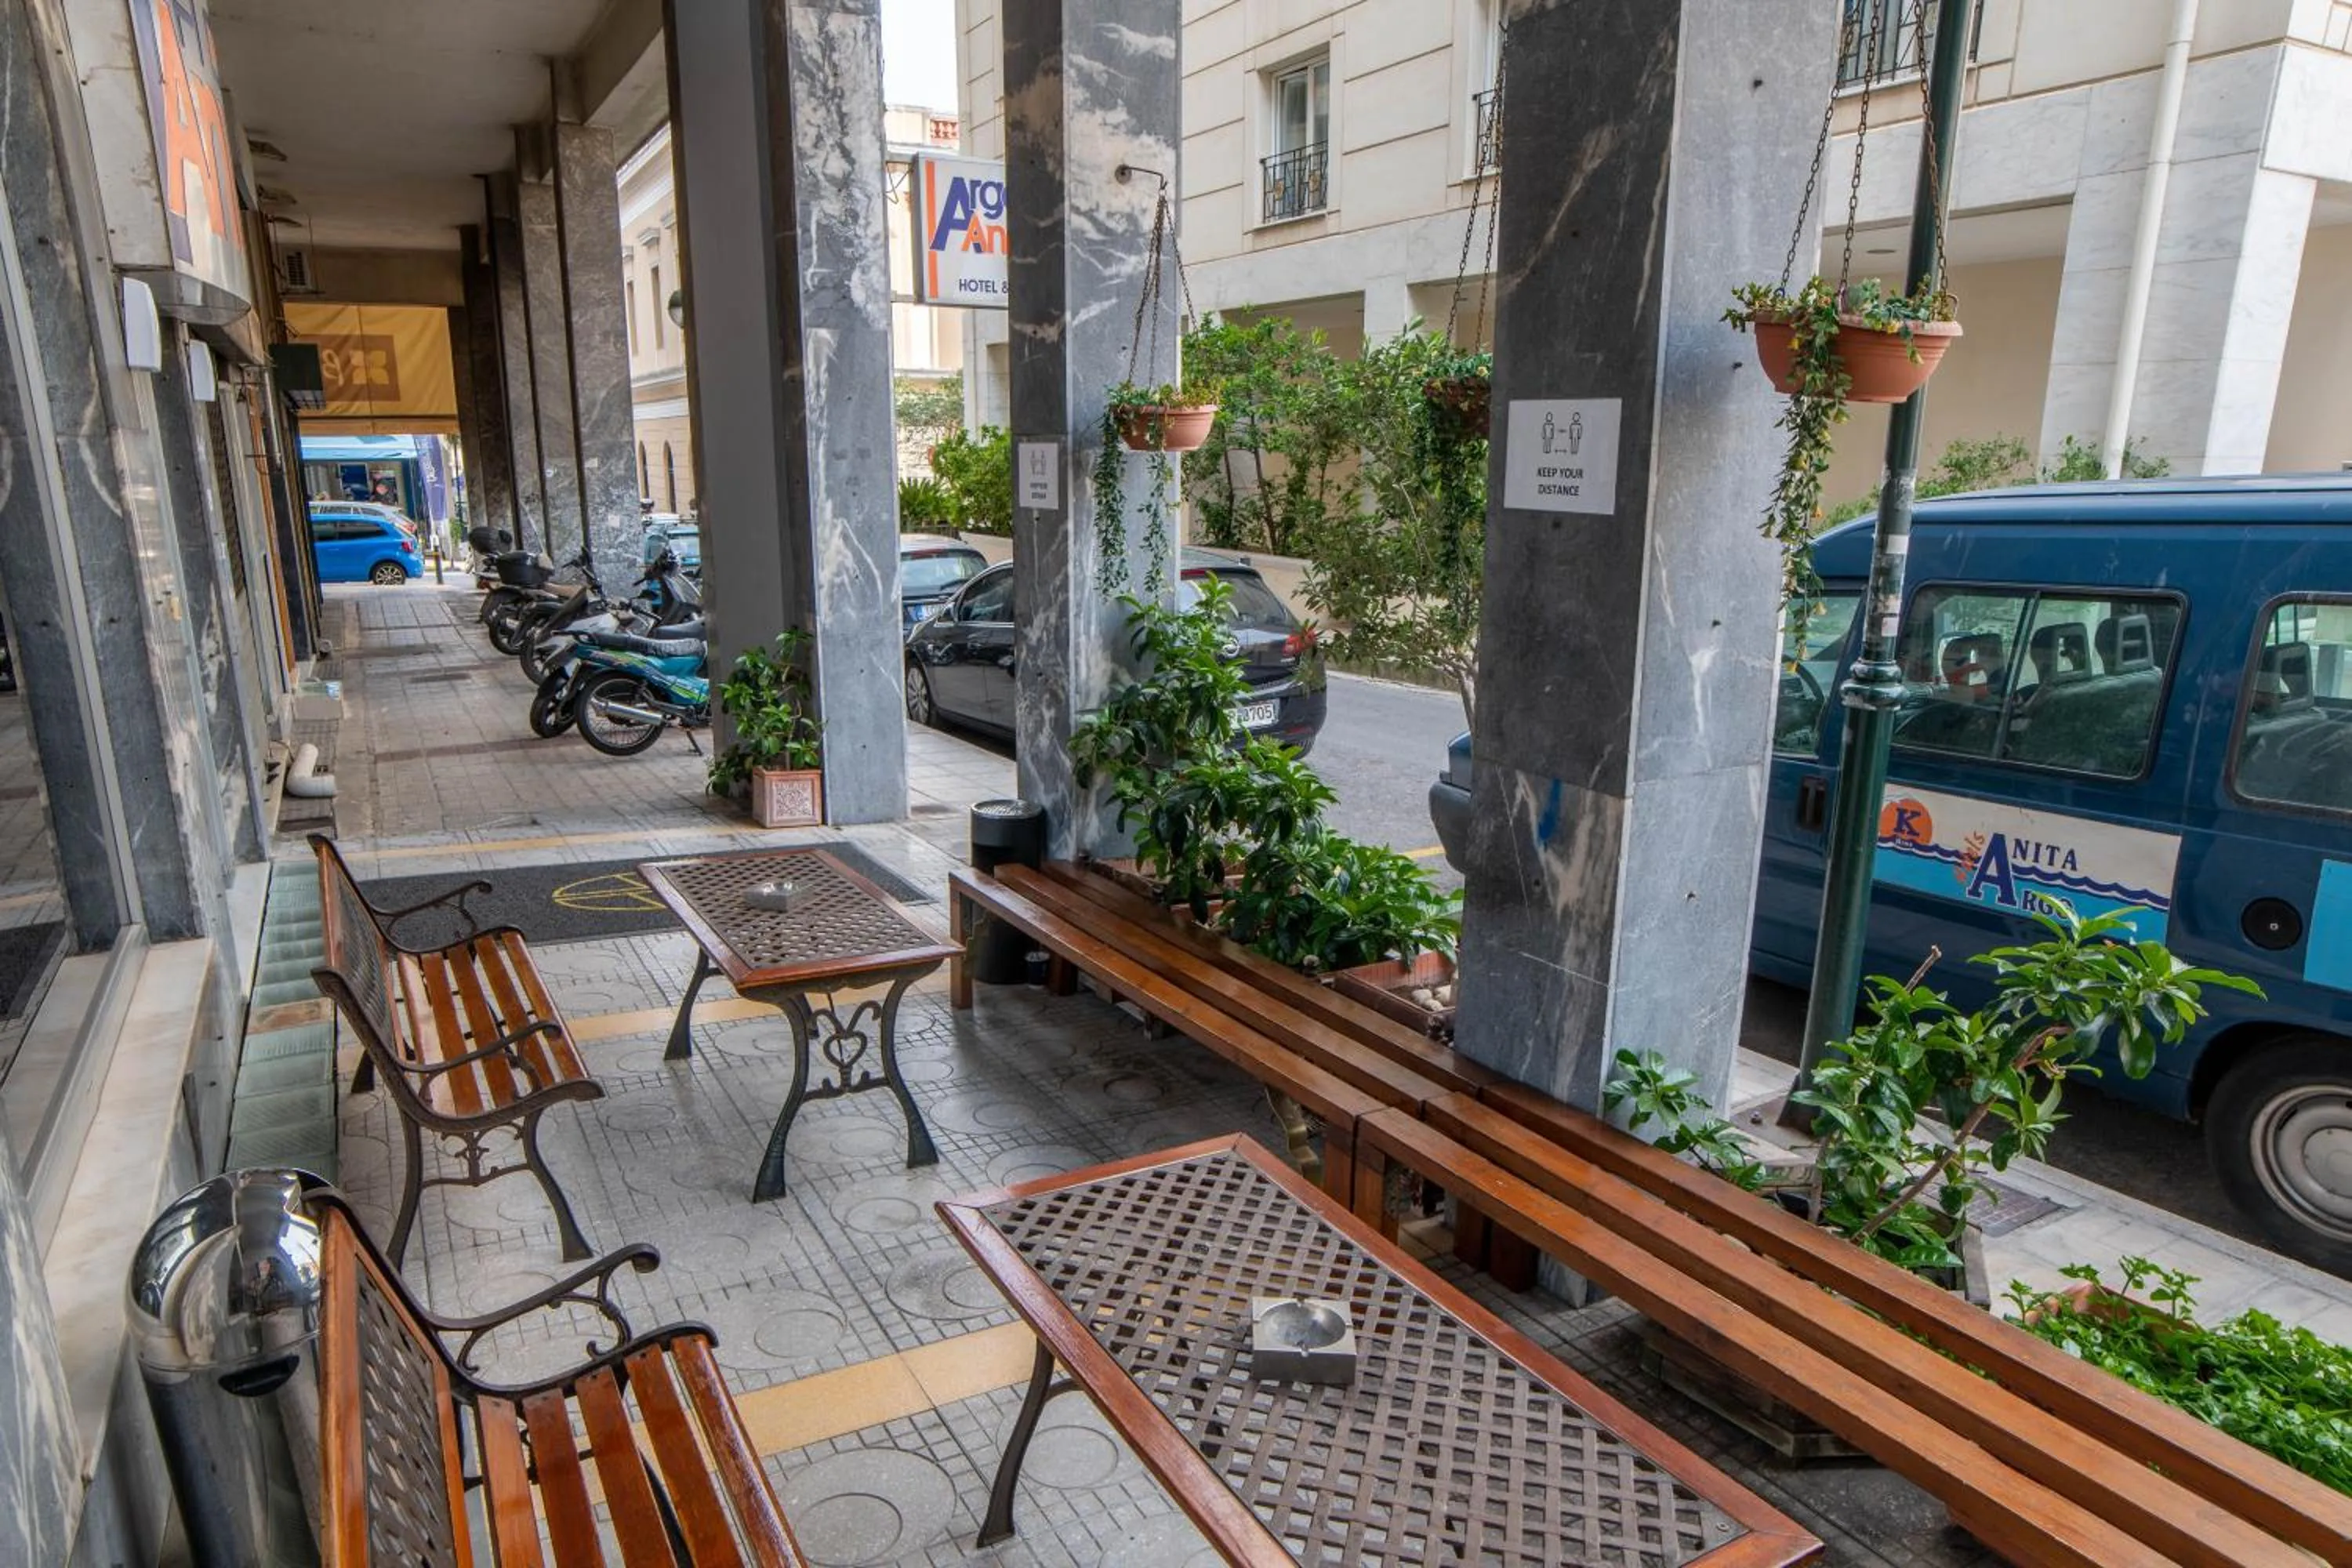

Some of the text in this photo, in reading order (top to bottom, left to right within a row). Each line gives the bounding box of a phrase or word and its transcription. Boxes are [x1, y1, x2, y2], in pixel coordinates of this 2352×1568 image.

[930, 176, 1007, 252] Arg
[959, 278, 998, 294] HOTEL
[1537, 467, 1584, 478] KEEP YOUR
[1537, 484, 1581, 496] DISTANCE
[1893, 807, 1922, 837] K
